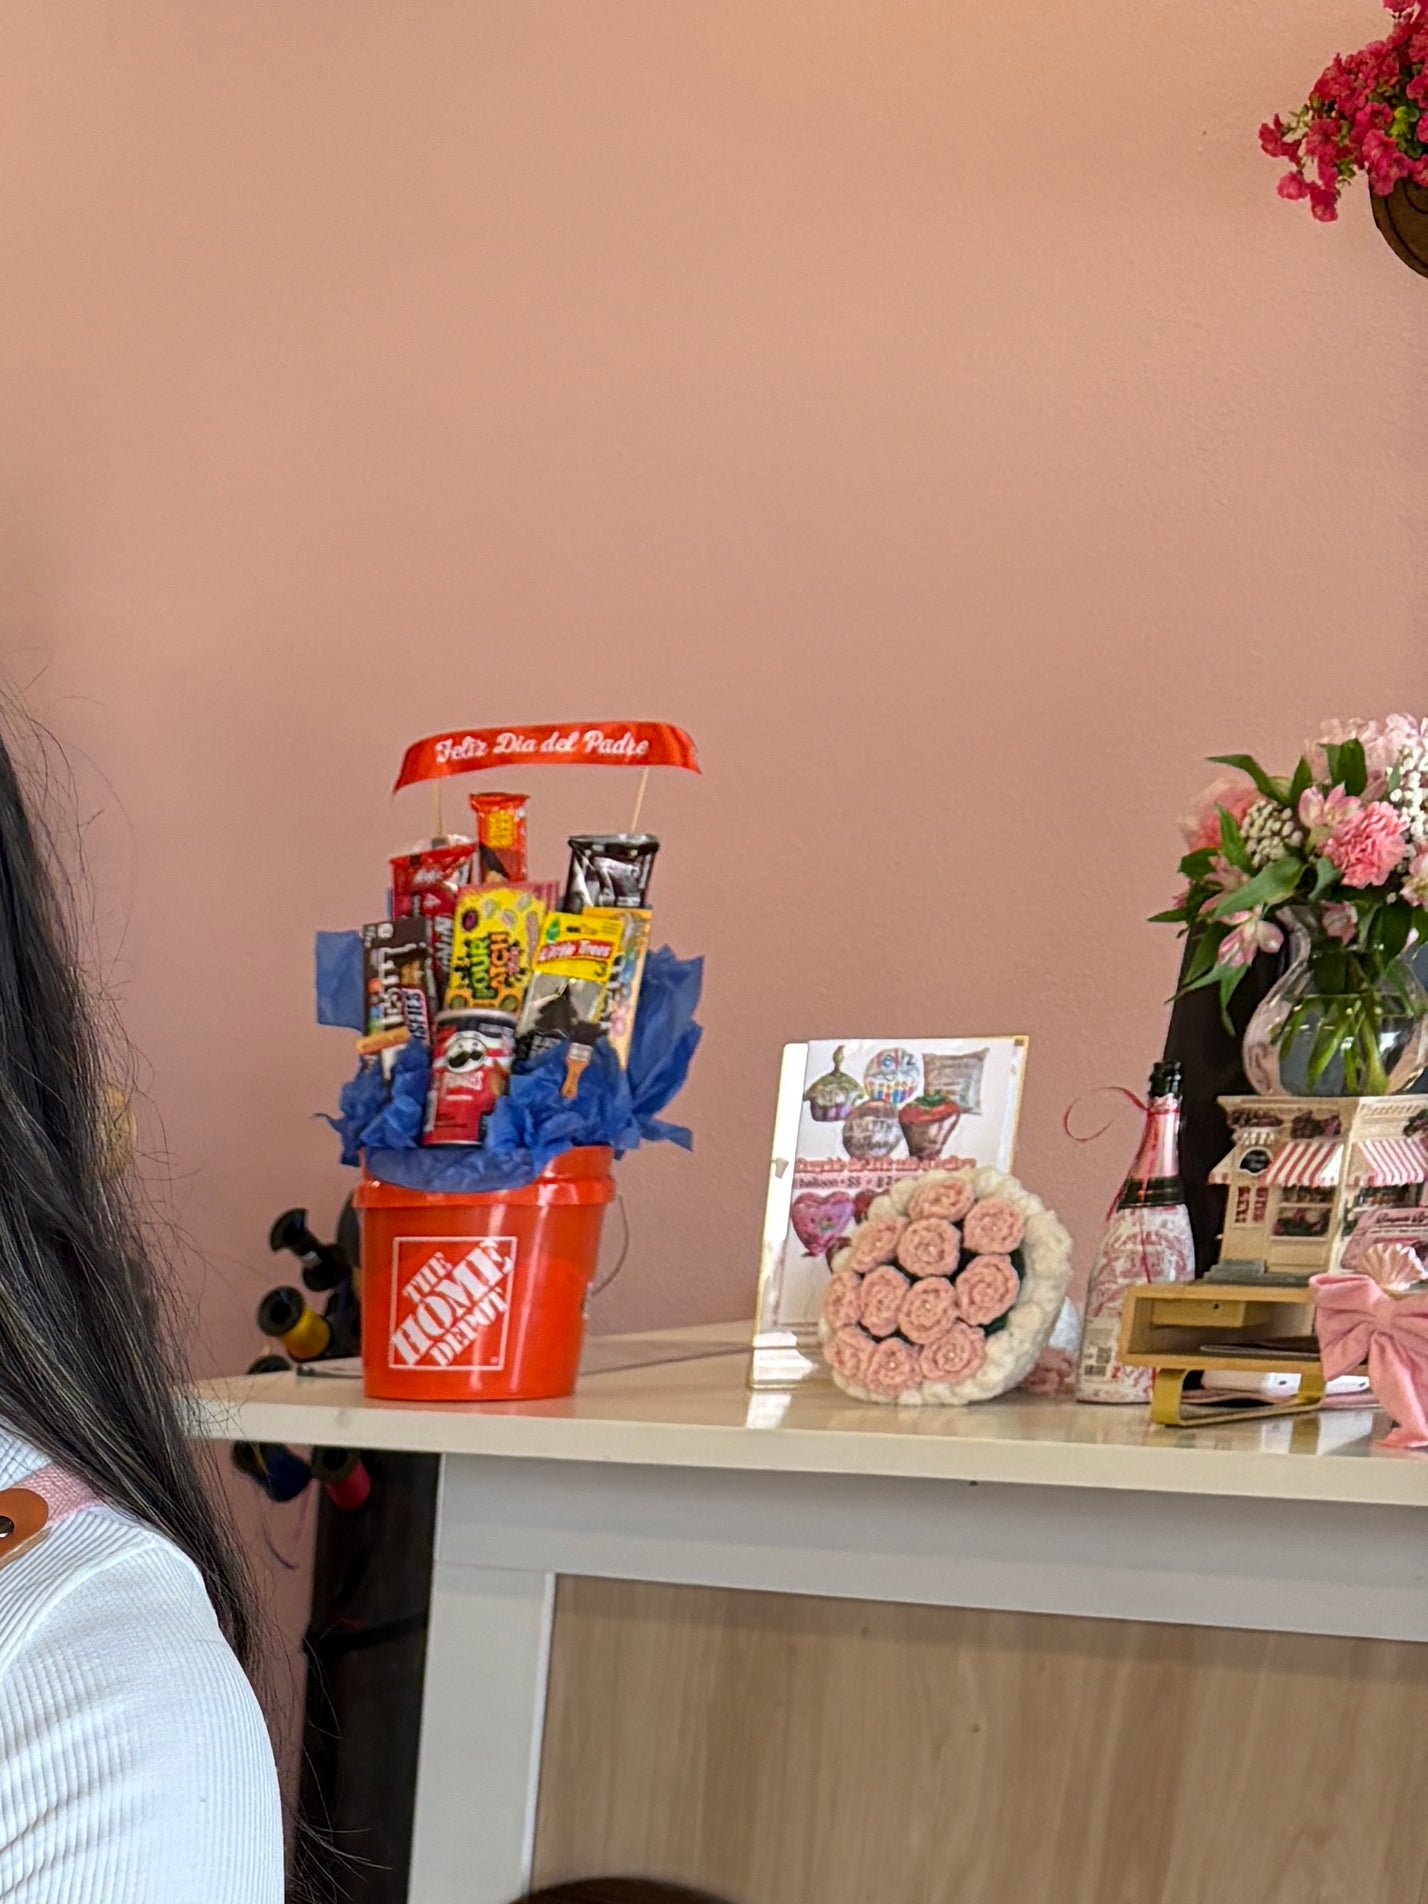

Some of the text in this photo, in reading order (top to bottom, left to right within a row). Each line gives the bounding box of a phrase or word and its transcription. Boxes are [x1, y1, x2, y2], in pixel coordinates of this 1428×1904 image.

[434, 734, 489, 764] Feliz
[540, 730, 581, 753] del
[584, 729, 650, 757] Padre
[391, 1238, 513, 1366] HOME
[403, 1251, 453, 1304] THE
[429, 1286, 508, 1367] DEPOT
